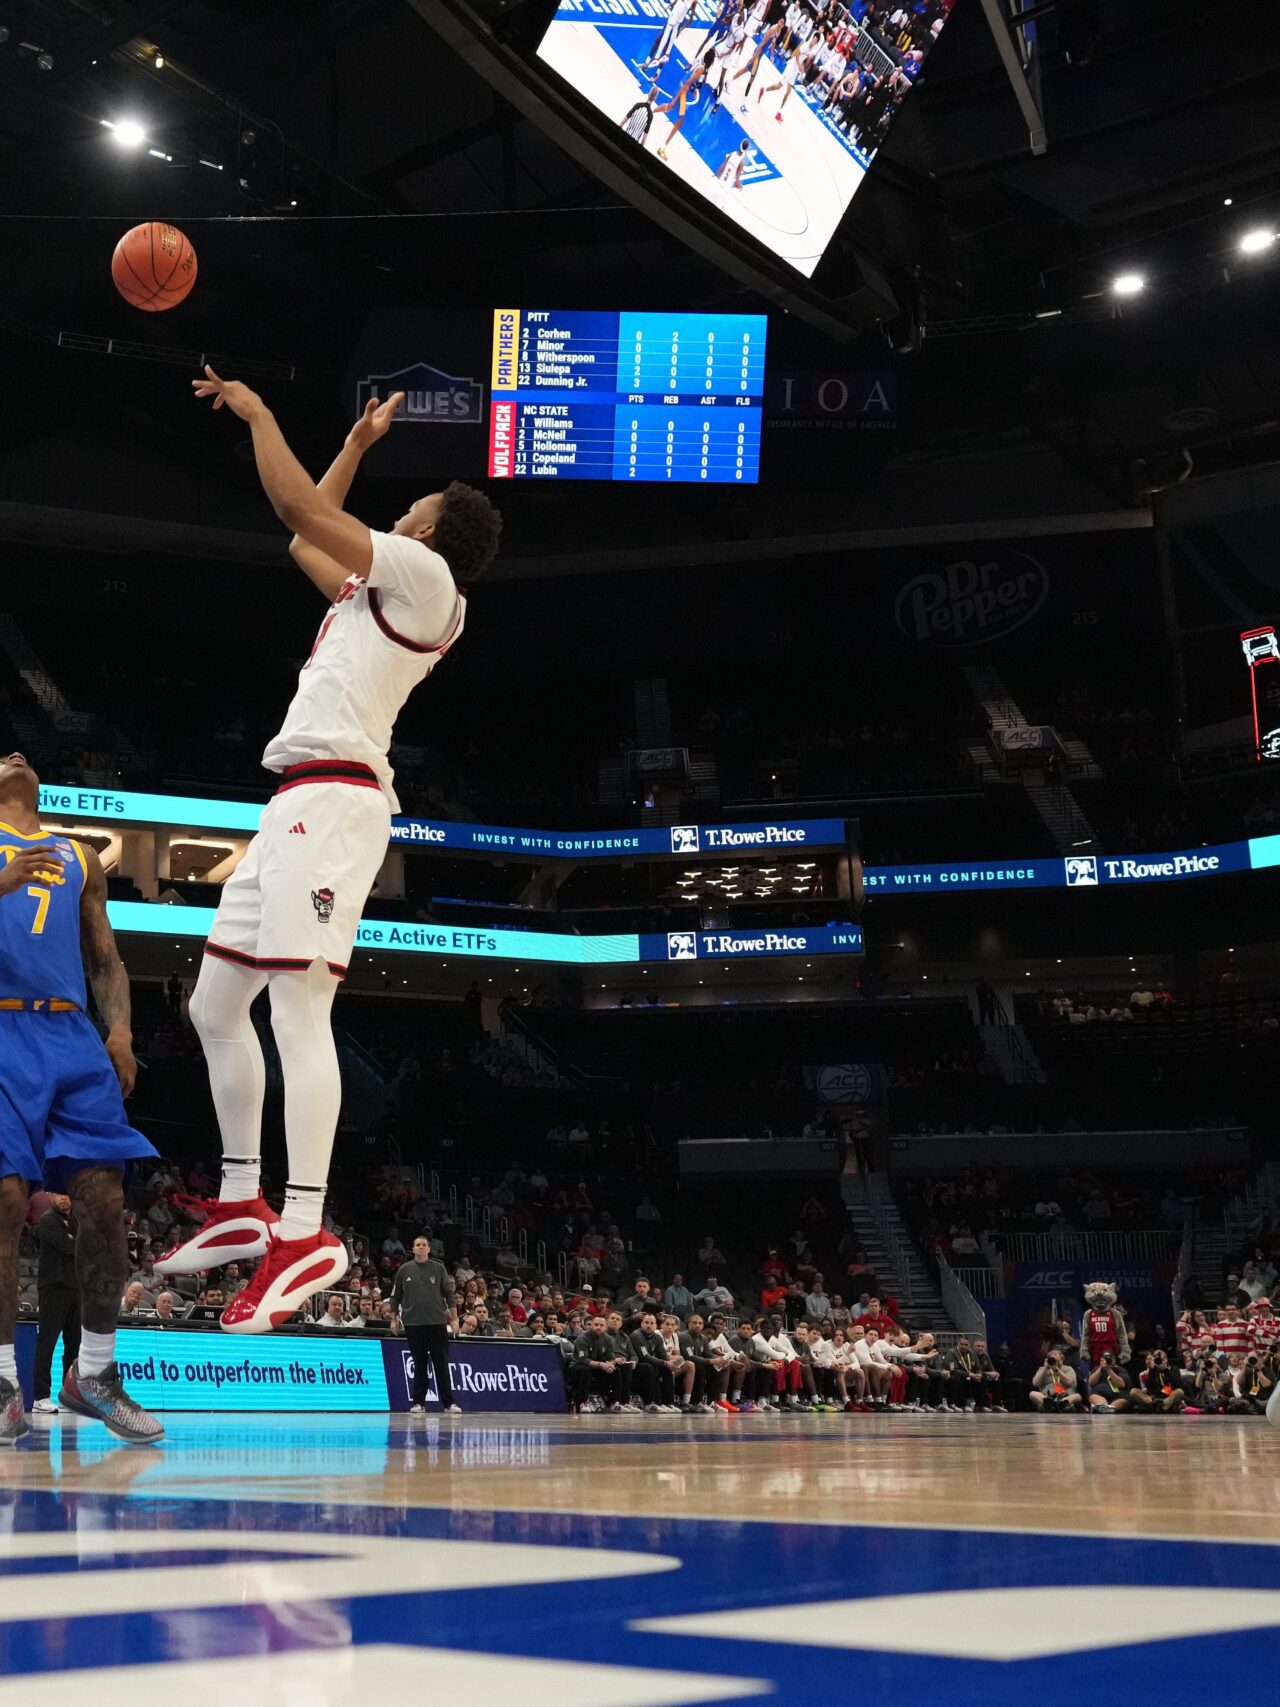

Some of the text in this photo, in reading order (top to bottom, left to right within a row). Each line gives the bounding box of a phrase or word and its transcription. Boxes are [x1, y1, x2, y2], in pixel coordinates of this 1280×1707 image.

[527, 312, 550, 322] PITT
[522, 328, 714, 342] 2 Corhen 0 2 0
[497, 313, 515, 385] PANTHERS
[522, 340, 714, 355] 7 Minor 0 0 1
[522, 351, 713, 366] 8 Witherspoon 0 0 0
[519, 363, 713, 377] 13 Siulepa 2 0 0
[518, 375, 712, 390] 22 Dunning Jr. 3 0 0
[628, 395, 750, 406] PTS REB AST FLS
[523, 405, 568, 416] NC STATE
[520, 418, 710, 432] 1 Williams 0 0 0
[493, 404, 511, 477] WOLFPACK
[519, 429, 709, 443] 2 McNeil 0 0 0
[518, 441, 708, 455] 5 Holloman 0 0 0
[516, 453, 708, 467] 11 Copeland 0 0 0
[514, 465, 707, 479] 22 Lubin 2 1 0
[104, 580, 128, 593] 212
[944, 560, 1000, 603] Dr
[895, 571, 1037, 641] Pepper
[38, 790, 71, 807] tive
[78, 794, 125, 813] ETFs
[473, 833, 515, 845] INVEST
[521, 837, 551, 849] WITH
[557, 838, 639, 850] CONFIDENCE
[862, 876, 887, 886] EST
[895, 874, 932, 884] WITH
[939, 868, 1035, 883] CONFIDENCE
[28, 886, 51, 935] 7
[357, 925, 383, 944] ice
[389, 927, 447, 948] Active
[451, 931, 497, 951] ETFs
[832, 935, 862, 946] INV
[825, 1074, 866, 1087] ACC
[1024, 1271, 1075, 1285] ACC
[1095, 1322, 1108, 1333] 00
[117, 1356, 369, 1387] ned to outperform the index.
